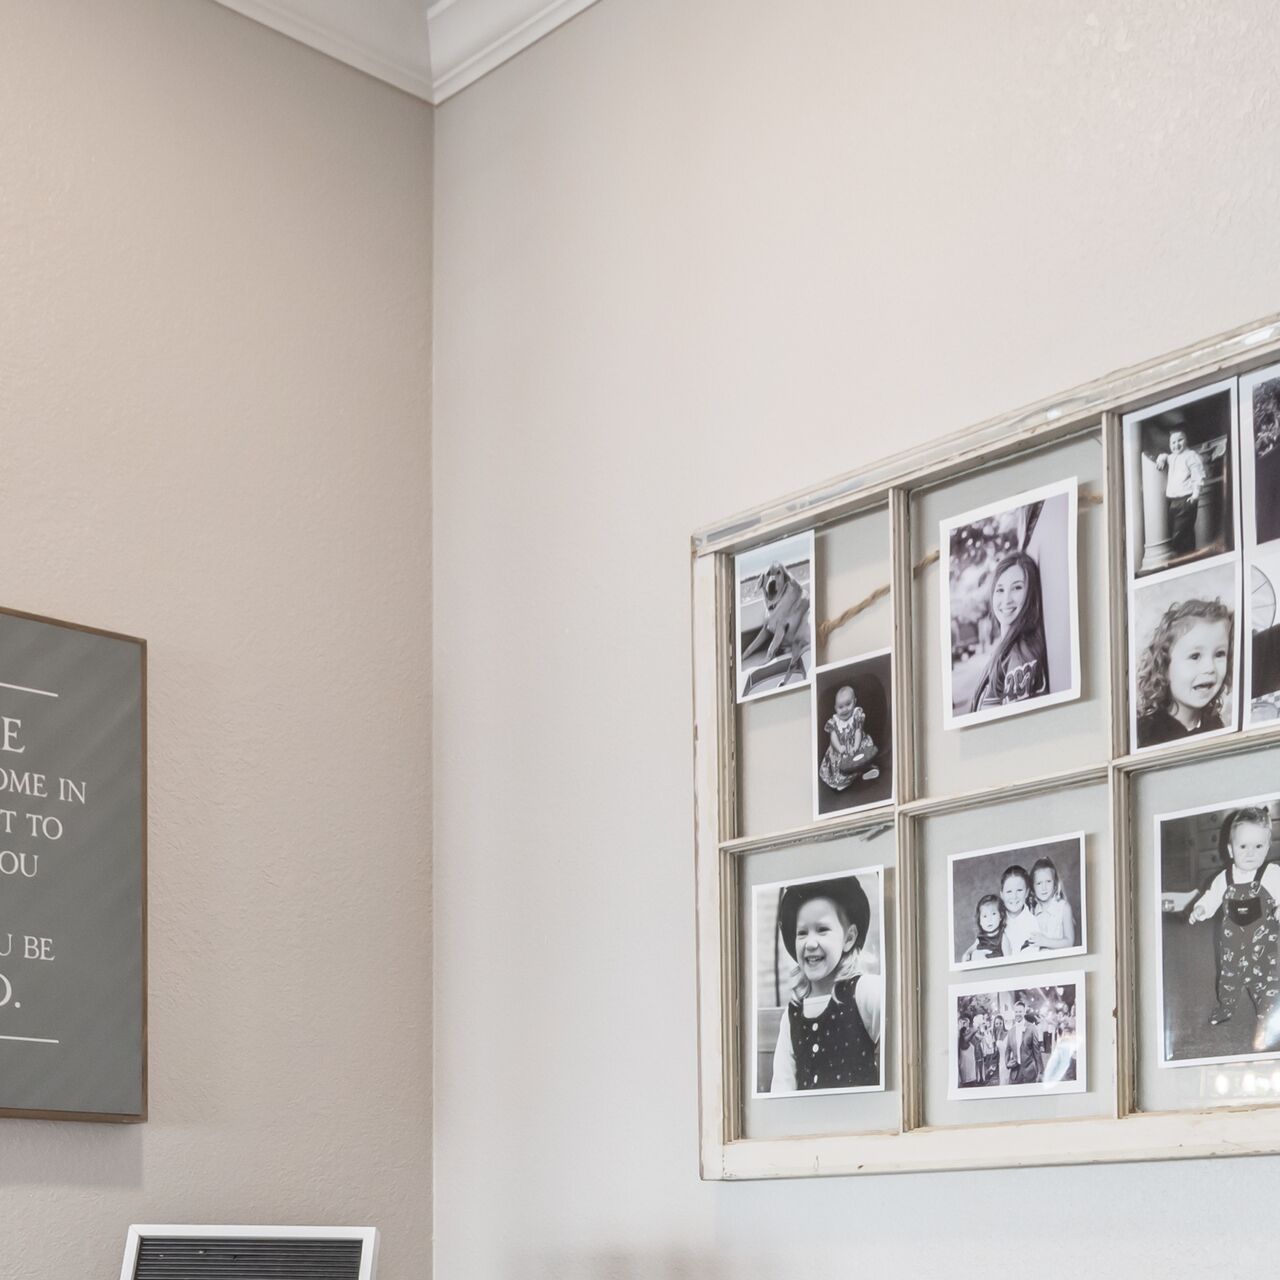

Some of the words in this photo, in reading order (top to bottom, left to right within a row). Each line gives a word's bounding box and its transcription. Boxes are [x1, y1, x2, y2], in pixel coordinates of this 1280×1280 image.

[58, 777, 87, 805] IN
[25, 813, 63, 840] TO
[23, 935, 56, 961] BE
